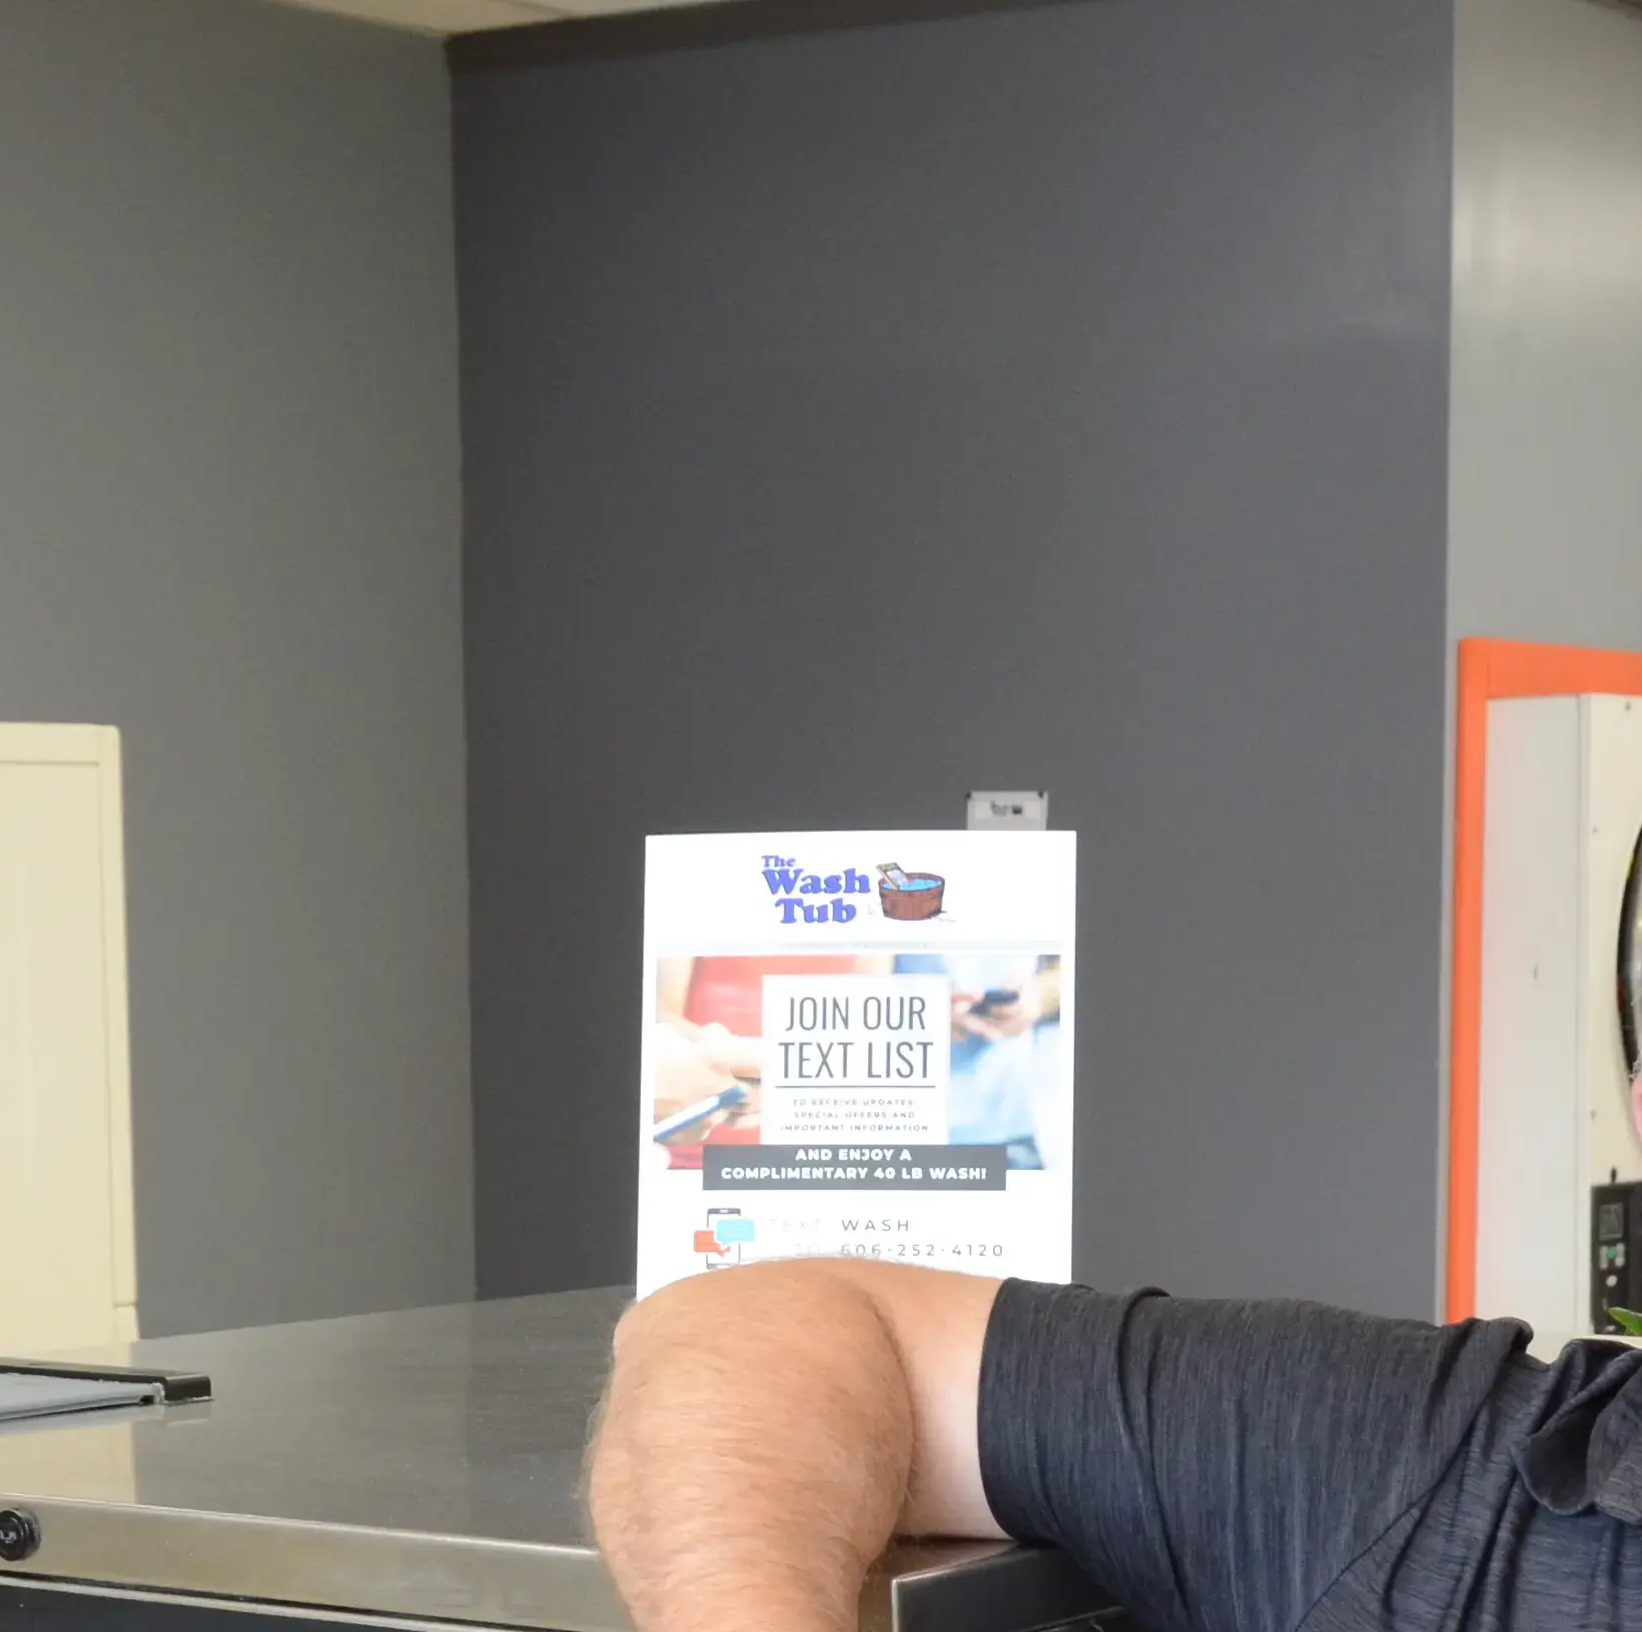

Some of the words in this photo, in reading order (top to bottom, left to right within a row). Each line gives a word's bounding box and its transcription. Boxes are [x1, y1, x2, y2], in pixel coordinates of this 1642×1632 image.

[761, 854, 796, 868] The
[761, 868, 871, 895] Wash
[774, 898, 857, 924] Tub
[785, 996, 850, 1032] JOIN
[862, 996, 927, 1032] OUR
[778, 1041, 854, 1079] TEXT
[866, 1041, 934, 1079] LIST
[863, 1098, 914, 1106] UPDATES
[780, 1124, 845, 1132] IMPORTANT
[850, 1124, 929, 1132] INFORMATION
[795, 1149, 832, 1161] AND
[838, 1149, 893, 1162] ENJOY
[899, 1149, 911, 1161] A
[721, 1166, 868, 1180] COMPLIMENTARY
[873, 1167, 896, 1180] 40
[902, 1167, 923, 1179] LB
[929, 1166, 987, 1180] WASH!
[768, 1219, 822, 1231] TEXT
[841, 1219, 910, 1232] WASH
